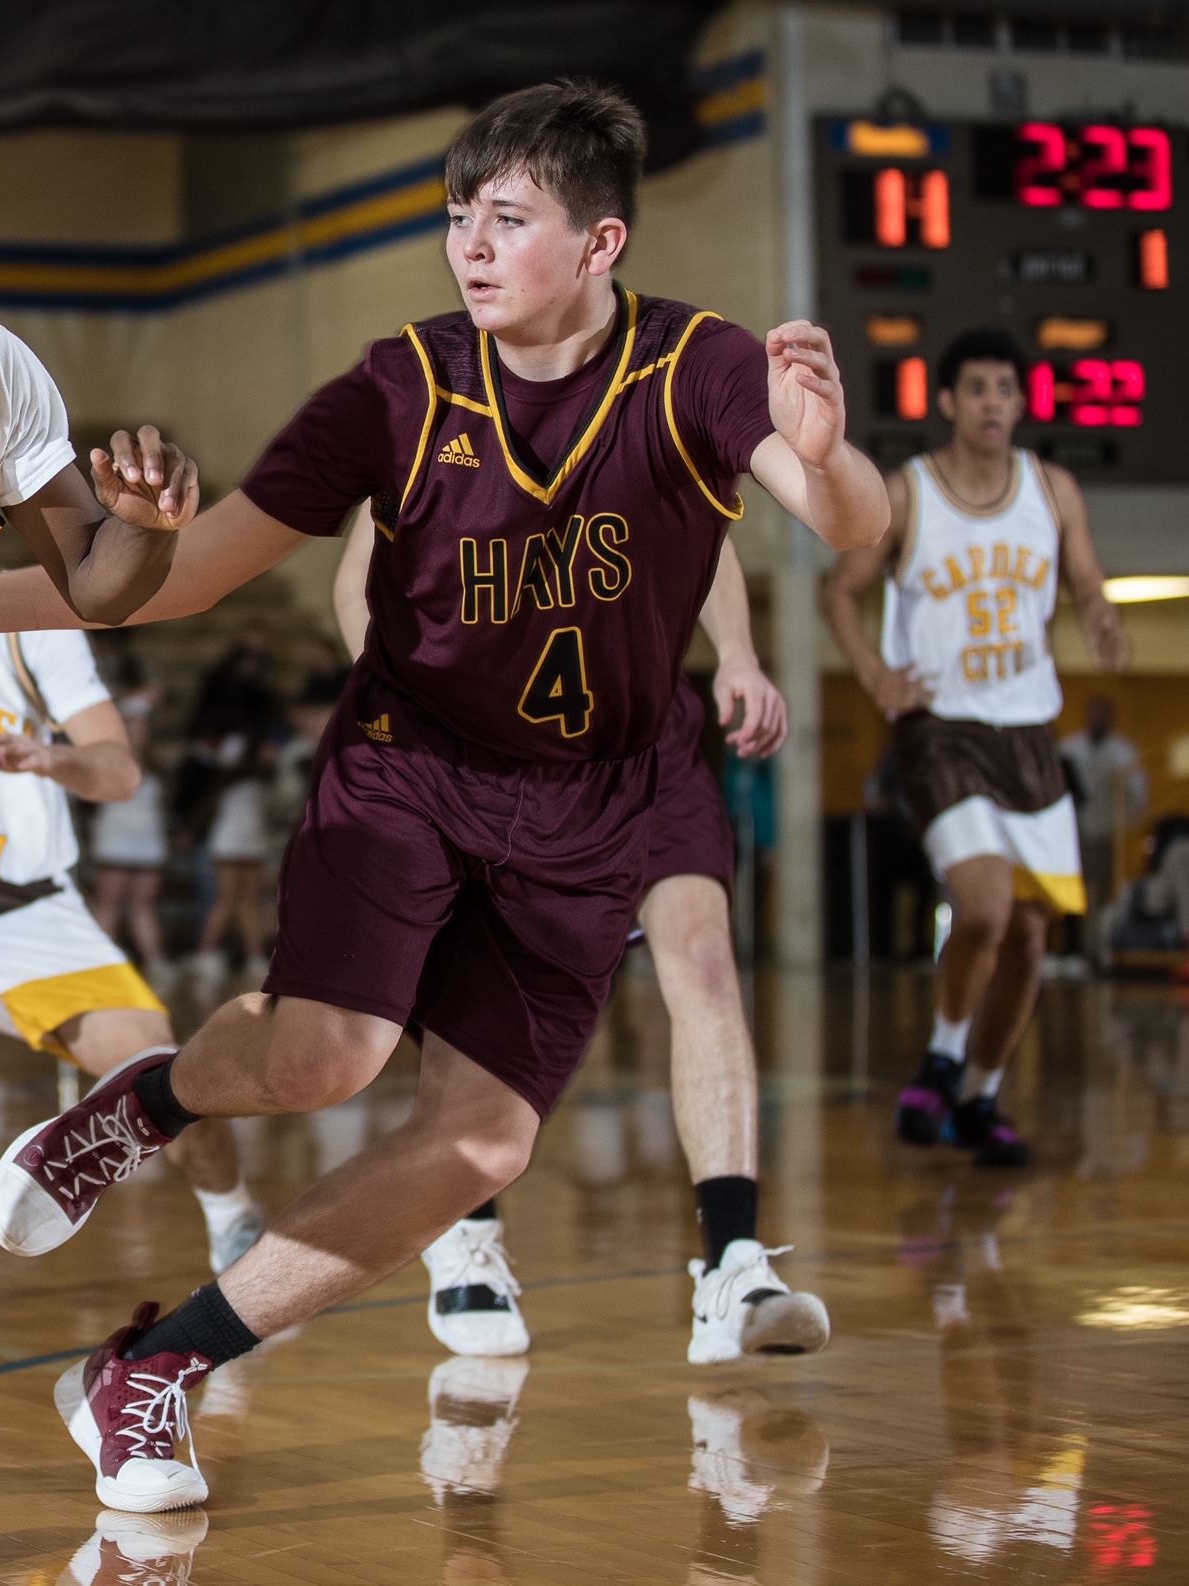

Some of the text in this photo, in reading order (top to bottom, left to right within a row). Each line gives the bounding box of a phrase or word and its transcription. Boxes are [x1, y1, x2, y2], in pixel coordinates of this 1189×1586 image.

[1016, 122, 1172, 211] 2:23
[1138, 228, 1169, 289] 1
[896, 355, 928, 420] 1
[437, 451, 481, 468] adidas
[460, 513, 632, 624] HAYS
[966, 586, 1018, 637] 52
[517, 626, 594, 738] 4
